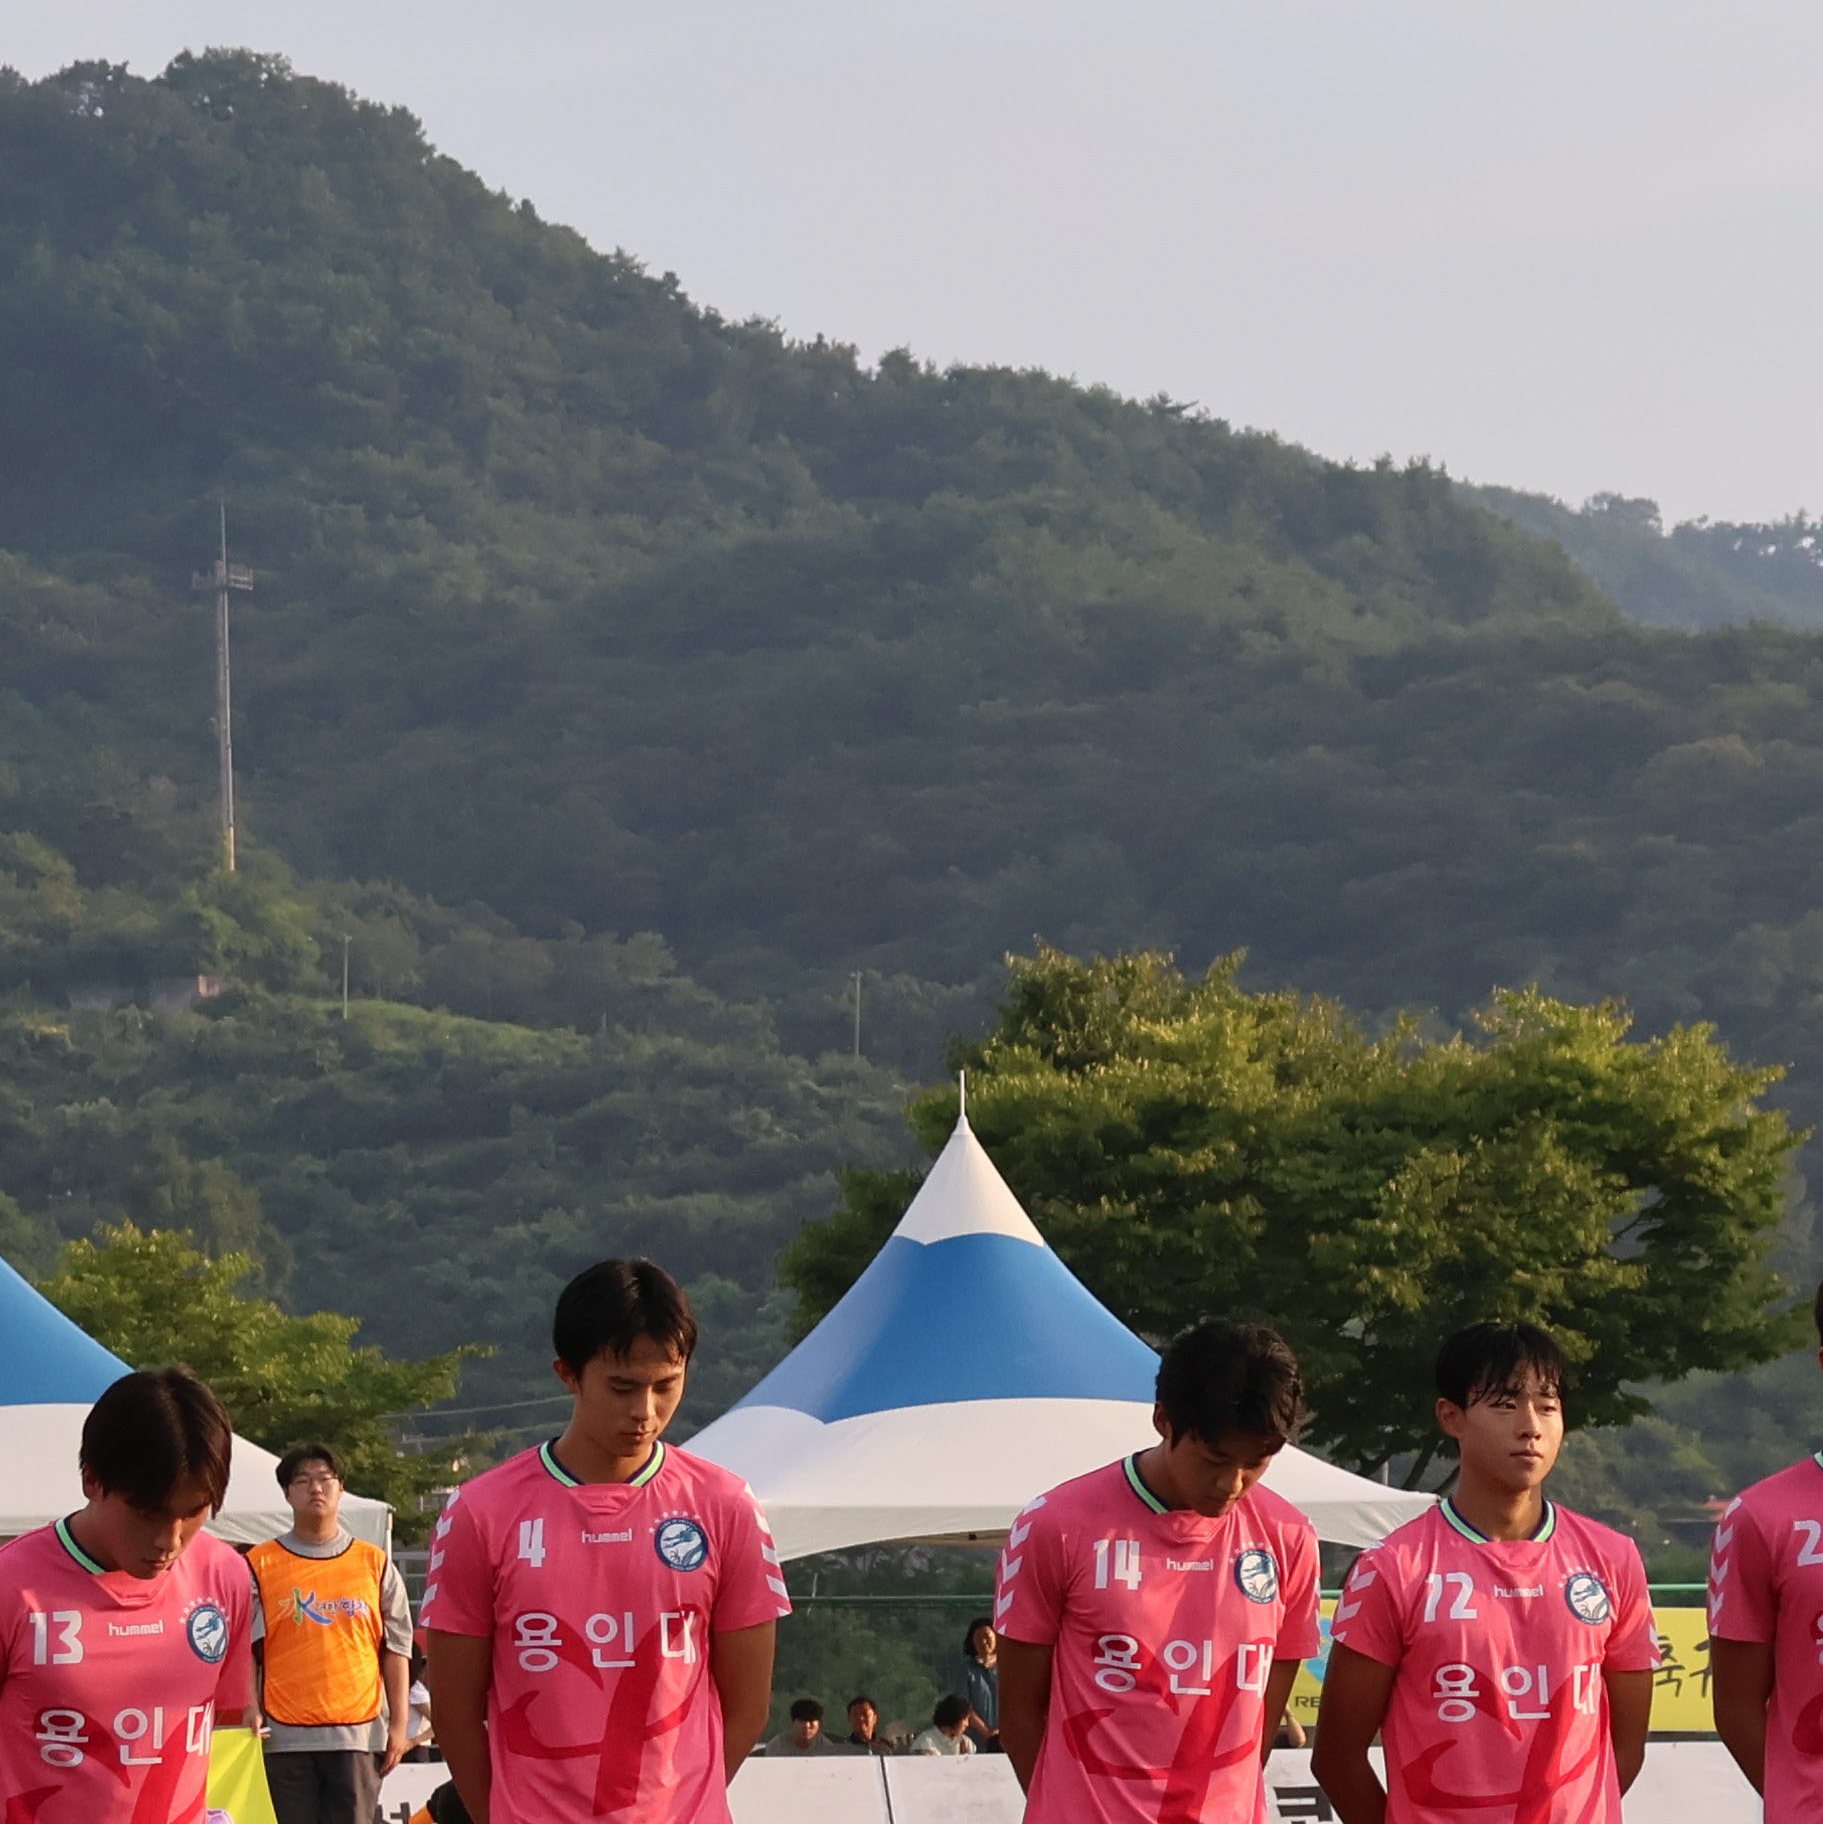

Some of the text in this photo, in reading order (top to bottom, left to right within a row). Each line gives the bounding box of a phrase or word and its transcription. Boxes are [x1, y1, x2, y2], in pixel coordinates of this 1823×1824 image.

[517, 1518, 546, 1567] 4
[581, 1528, 633, 1544] hummel
[1093, 1540, 1142, 1590] 14
[1166, 1558, 1214, 1571] hummel
[1423, 1572, 1478, 1622] 72
[1493, 1584, 1544, 1598] hummel
[29, 1610, 84, 1665] 13
[109, 1620, 164, 1637] hummel
[514, 1610, 697, 1672] 용인대
[1094, 1634, 1274, 1698] 용인대
[1433, 1663, 1600, 1723] 용인대
[36, 1700, 214, 1767] 용인대
